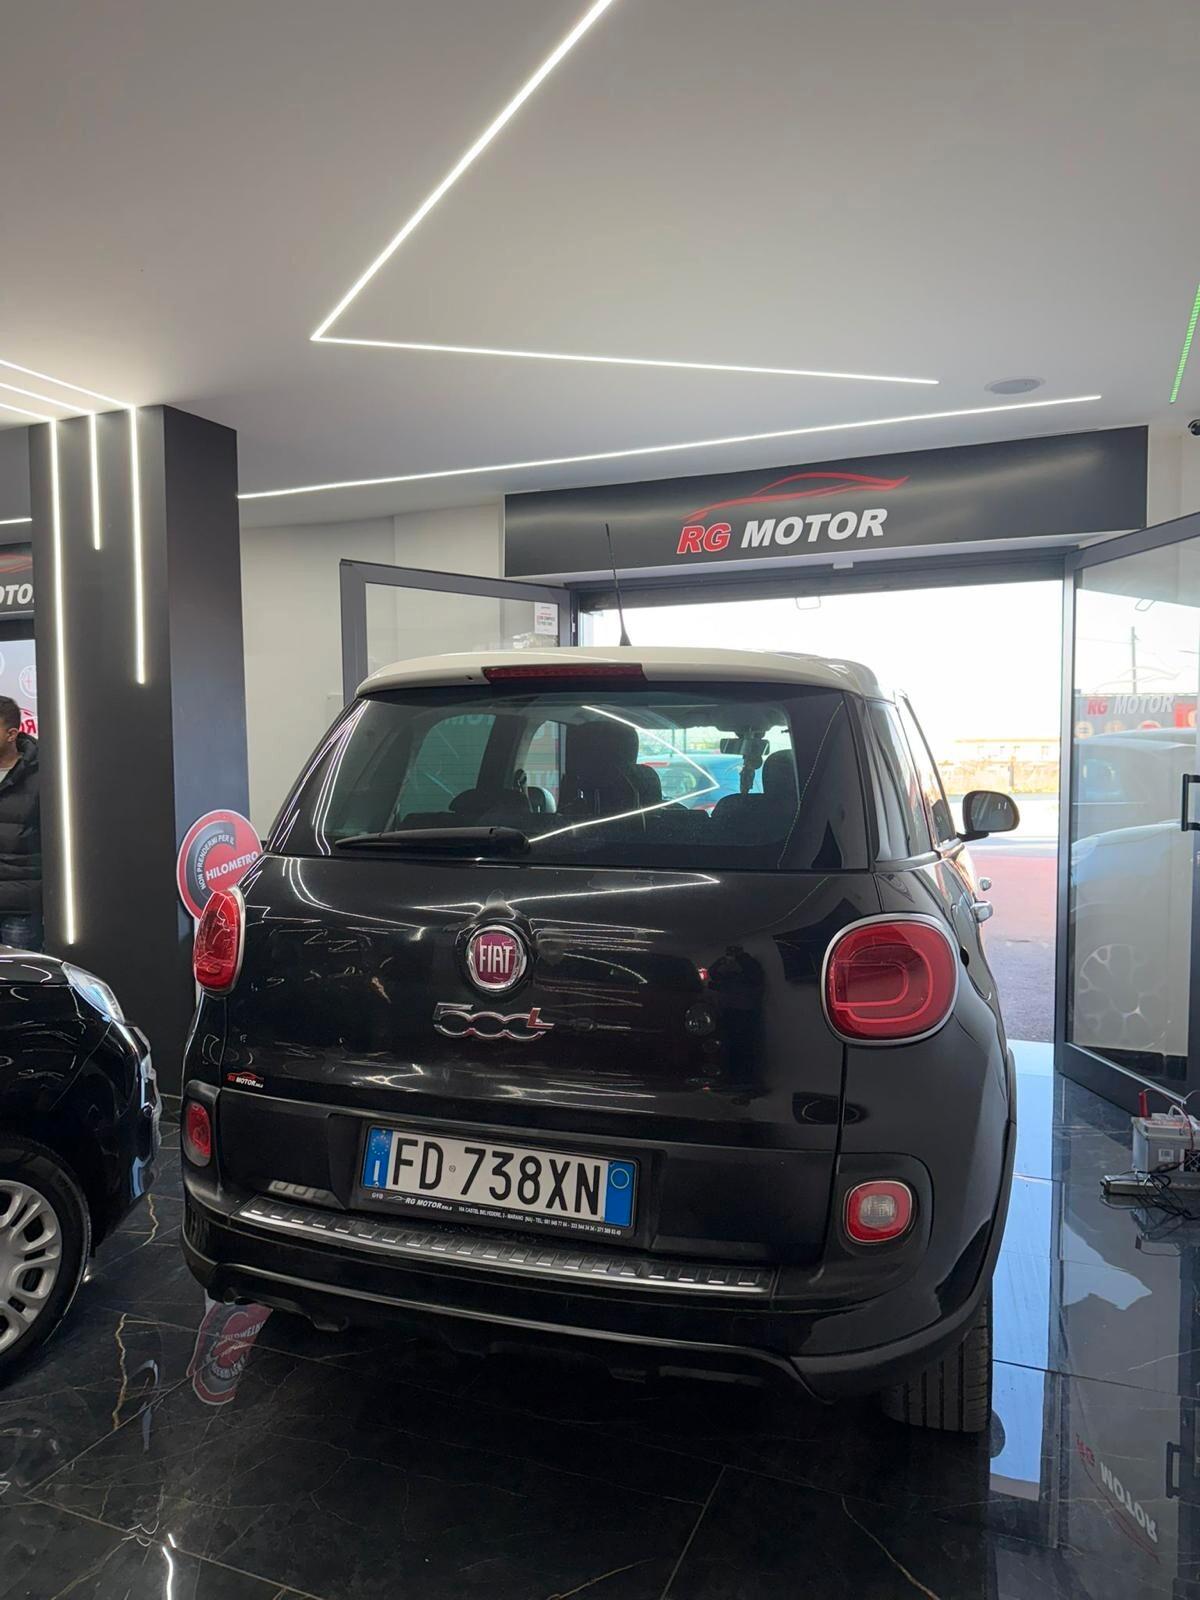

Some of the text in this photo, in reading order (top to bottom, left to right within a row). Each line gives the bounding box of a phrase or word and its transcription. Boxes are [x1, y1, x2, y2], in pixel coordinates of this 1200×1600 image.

[676, 508, 888, 554] RG MOTOR
[1113, 695, 1175, 714] MOTOR
[218, 834, 229, 843] PER
[197, 837, 218, 873] PRENDERMI
[196, 873, 206, 890] NON
[480, 944, 513, 974] FIAT
[432, 1002, 555, 1040] 500L
[236, 1076, 256, 1087] MOTOR
[392, 1137, 601, 1215] FD 738XN
[405, 1197, 416, 1205] RG
